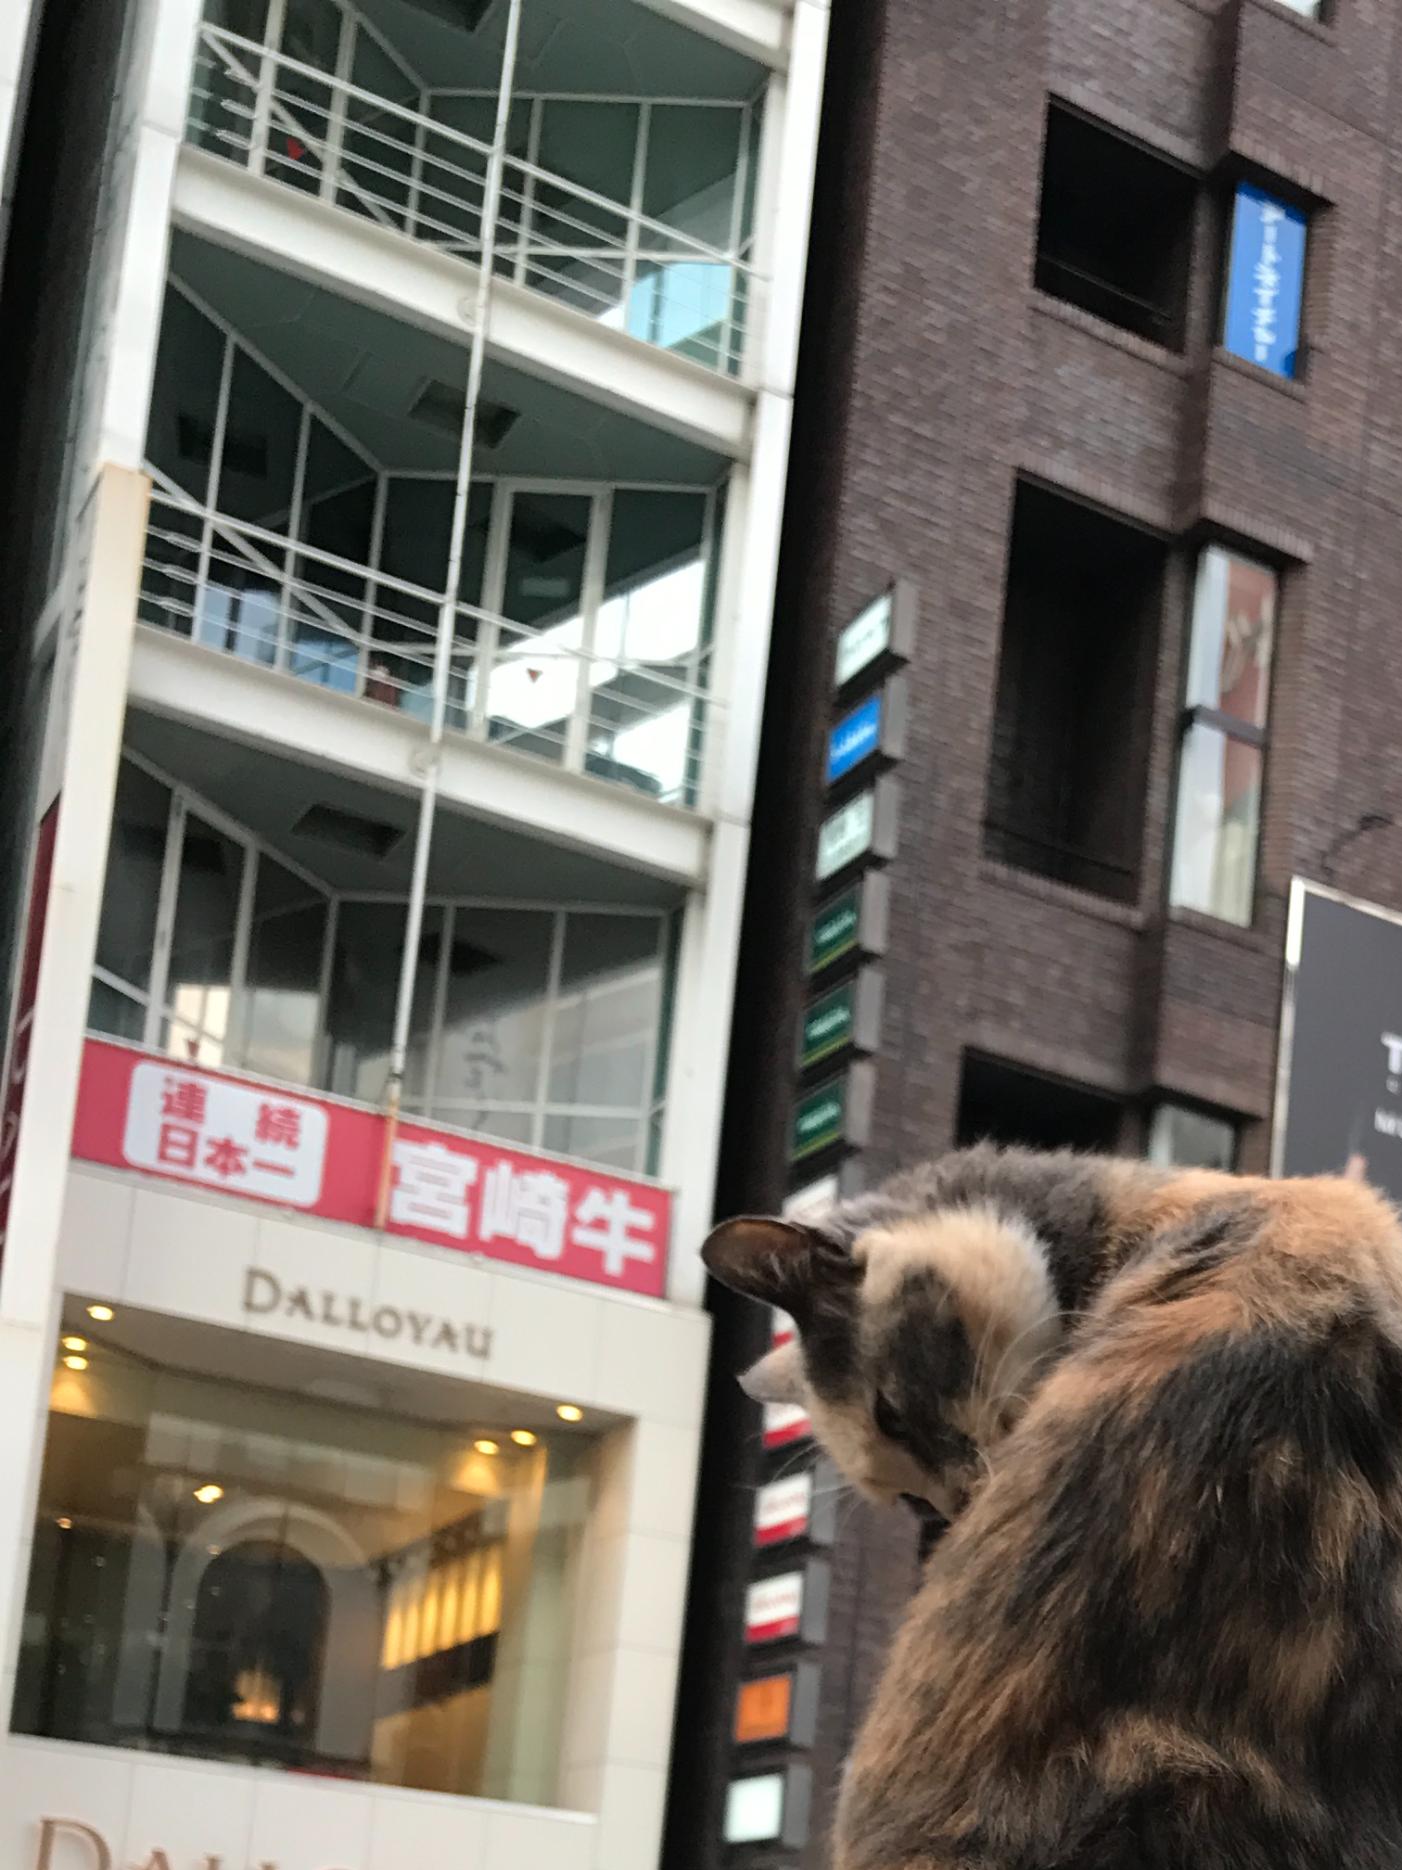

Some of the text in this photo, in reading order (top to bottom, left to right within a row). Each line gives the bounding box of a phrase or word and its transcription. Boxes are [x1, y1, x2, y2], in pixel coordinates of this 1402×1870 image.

[157, 1122, 295, 1177] 日本一
[242, 1263, 493, 1359] DALLOYAU
